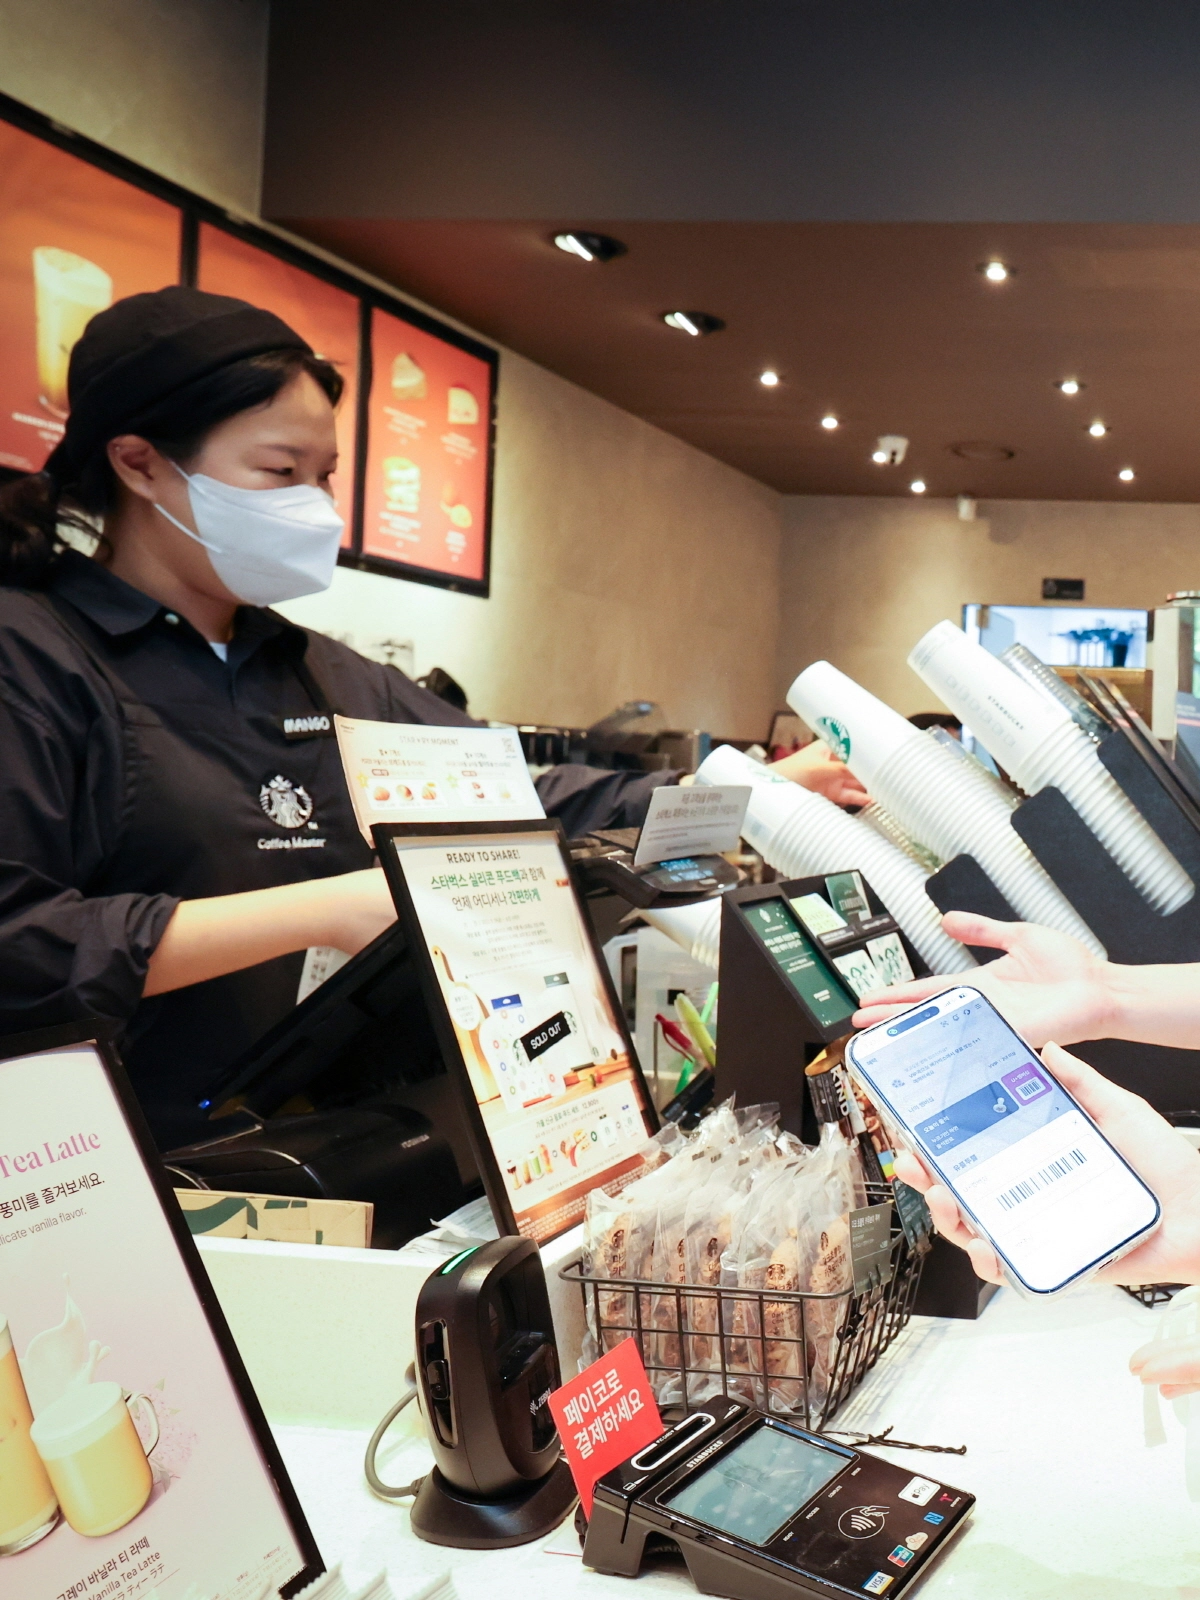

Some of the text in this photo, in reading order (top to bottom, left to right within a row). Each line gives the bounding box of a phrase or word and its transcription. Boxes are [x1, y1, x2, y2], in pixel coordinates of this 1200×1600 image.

[283, 716, 330, 733] MANGO
[257, 836, 326, 849] Coffee Master
[446, 849, 521, 864] READY TO SHARE!
[431, 874, 468, 890] 스타벅스
[468, 869, 496, 887] 실리콘
[528, 866, 546, 881] 함께
[451, 887, 541, 911] 언제 어디서나 간편하게
[530, 1021, 561, 1050] SOLD OUT
[831, 1063, 849, 1116] KIND
[0, 1132, 101, 1178] Tea Latte
[0, 1172, 105, 1219] 풍미를 즐겨보세요.
[28, 1217, 59, 1234] vanilla
[59, 1207, 87, 1223] flavor.
[562, 1368, 624, 1427] 페이코로
[573, 1388, 645, 1461] 결제하세요
[686, 1440, 724, 1469] STARBUCKS
[914, 1482, 931, 1496] Pay
[87, 1558, 118, 1585] 바닐라
[118, 1550, 130, 1563] 티
[129, 1536, 150, 1556] 라떼
[120, 1569, 138, 1583] Tea
[137, 1552, 161, 1573] Latte
[868, 1574, 886, 1591] VISA
